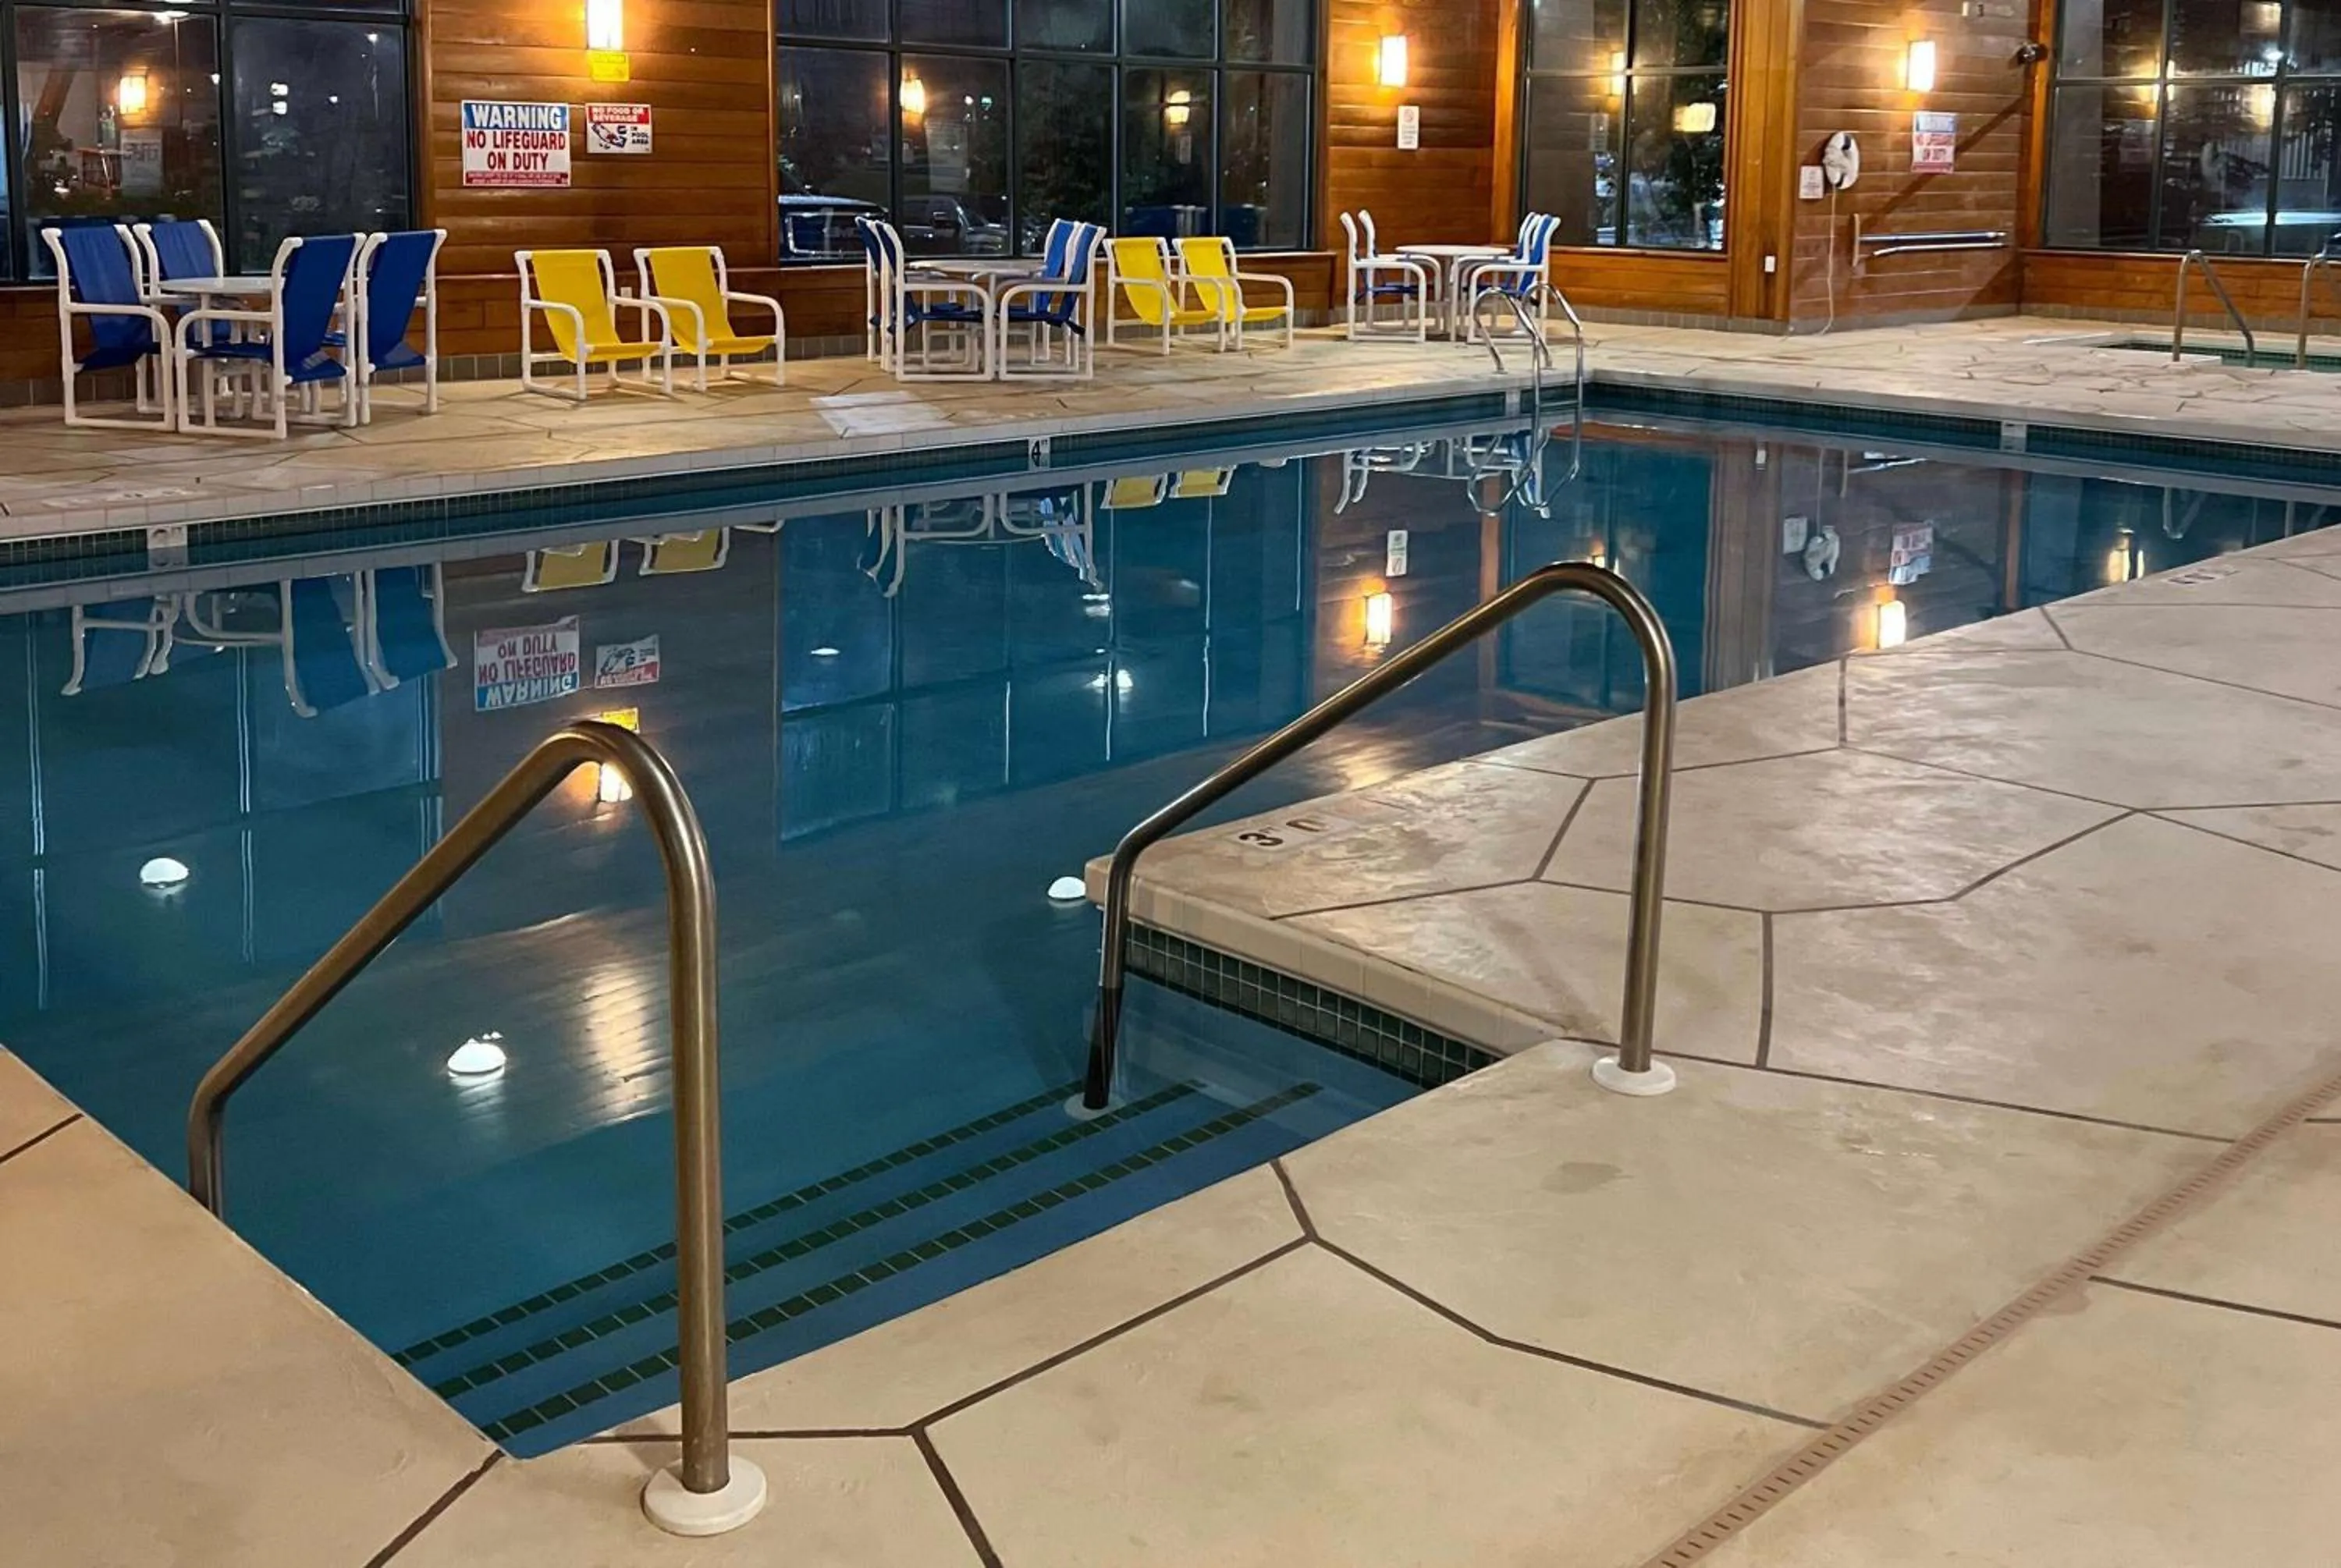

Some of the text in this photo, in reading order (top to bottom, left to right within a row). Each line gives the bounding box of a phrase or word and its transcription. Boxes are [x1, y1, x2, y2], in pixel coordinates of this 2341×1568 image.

[471, 105, 561, 129] WARNING
[467, 130, 566, 150] NO LIFEGUARD
[487, 151, 549, 170] ON DUTY
